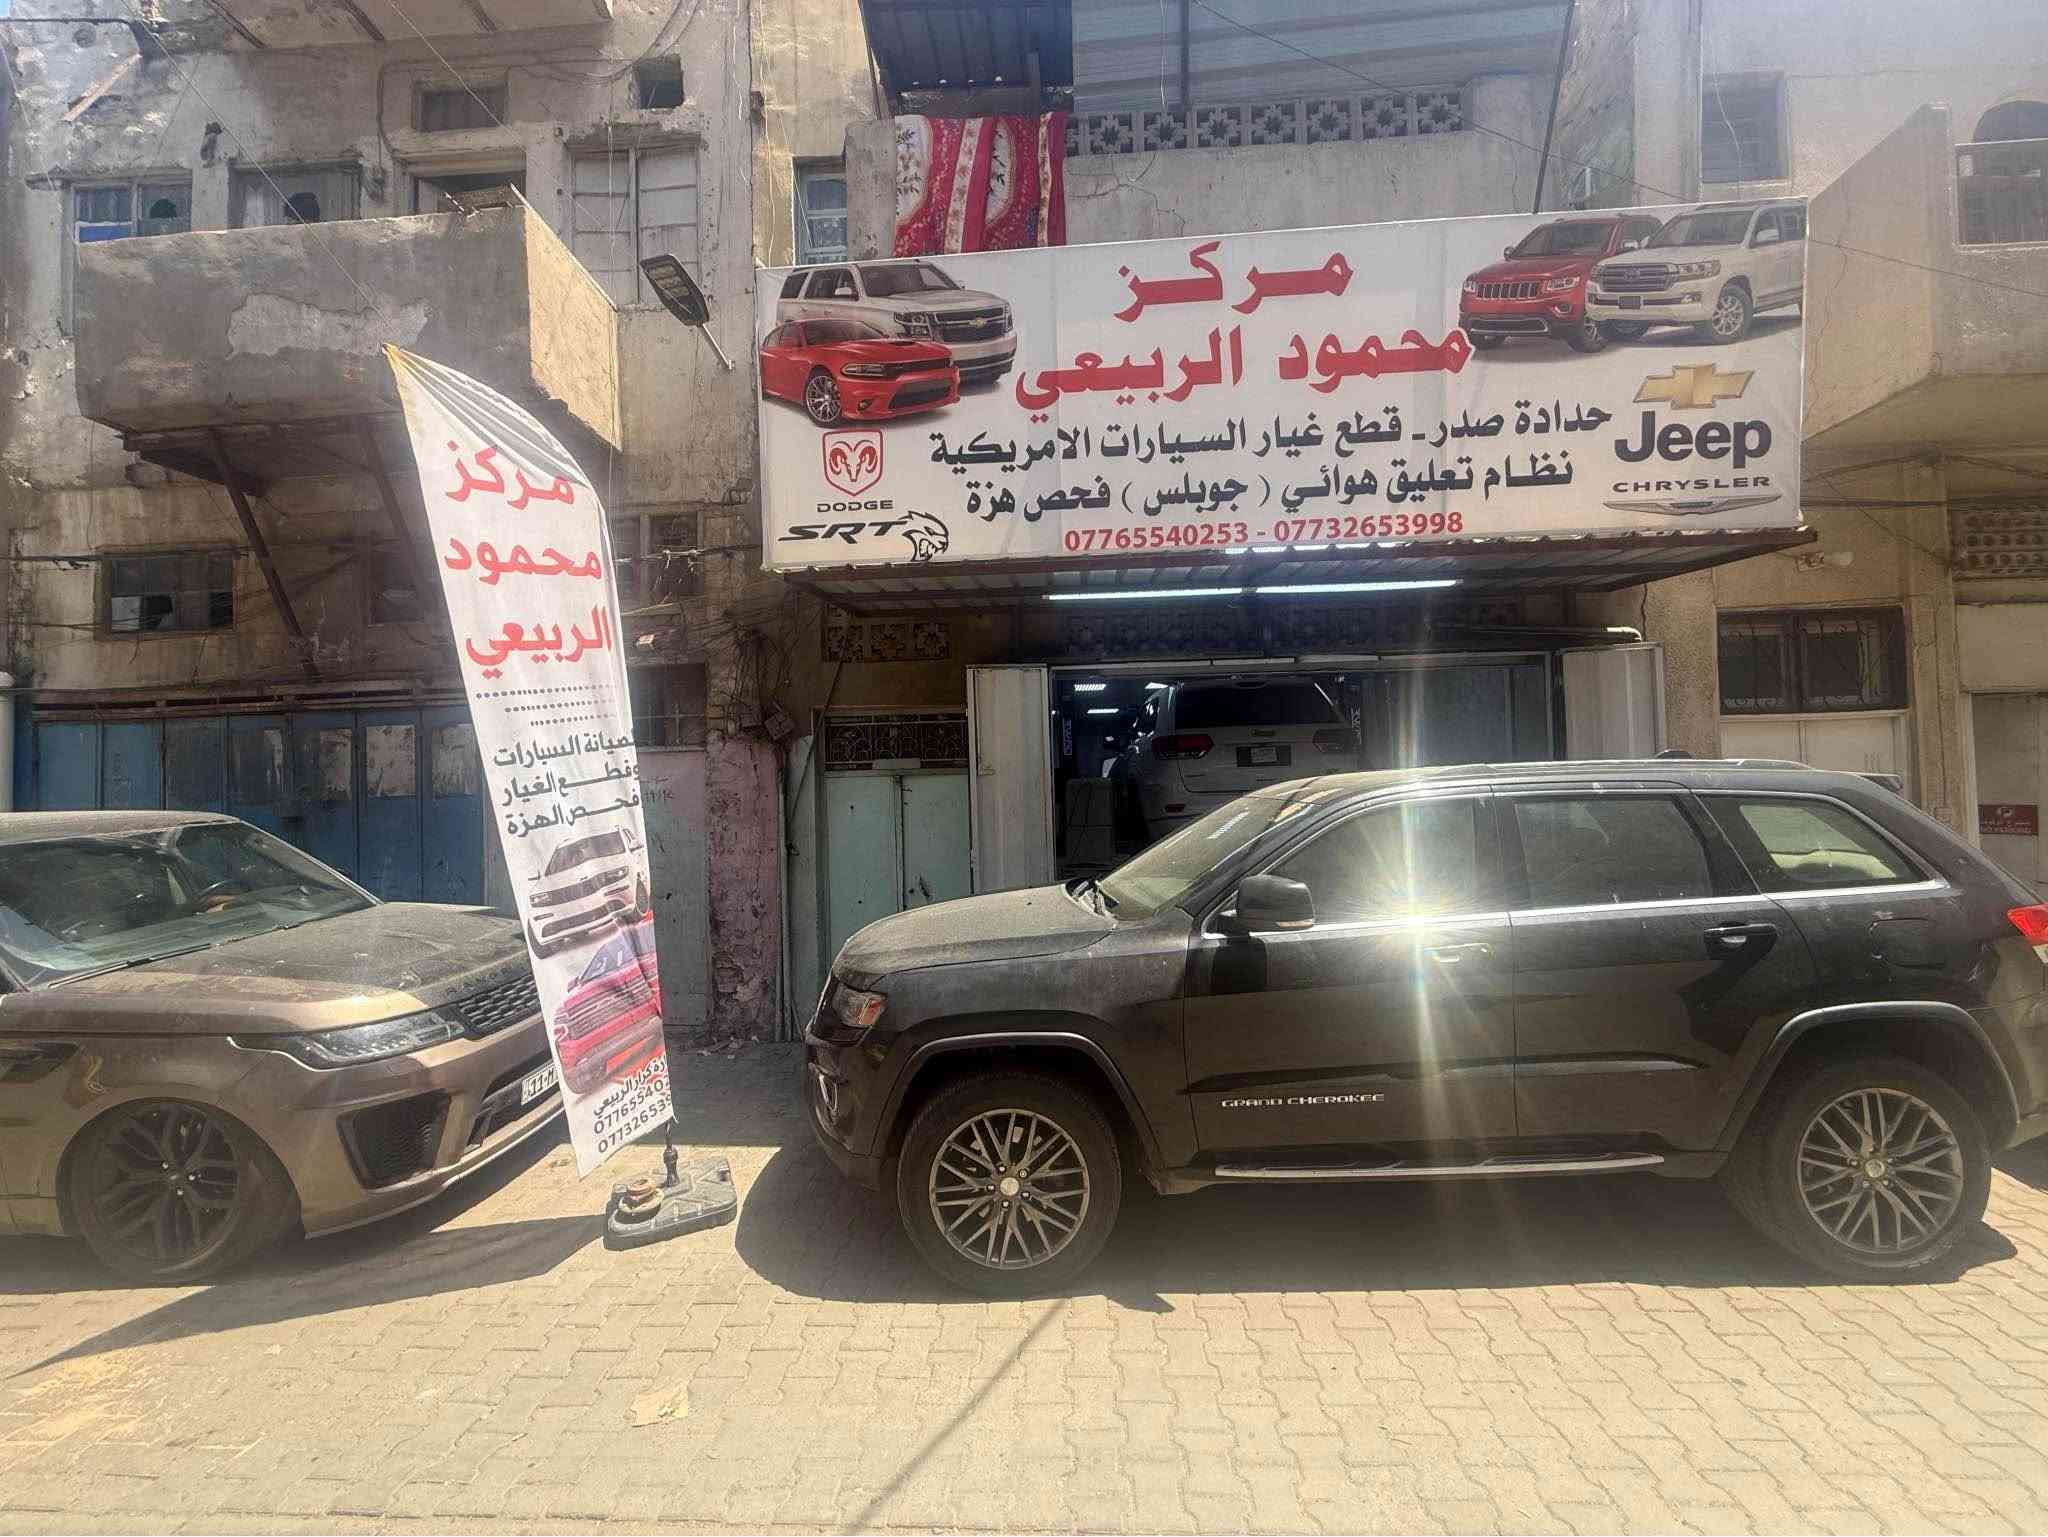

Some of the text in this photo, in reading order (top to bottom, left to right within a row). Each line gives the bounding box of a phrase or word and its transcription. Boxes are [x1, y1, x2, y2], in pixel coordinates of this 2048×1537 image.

[1113, 240, 1354, 323] مركز
[1015, 323, 1474, 423] محمود الربيعي
[1100, 416, 1247, 465] السيارات
[1253, 411, 1323, 459] غيار
[1335, 405, 1402, 458] قطع
[1514, 399, 1613, 436] حدادة
[1613, 410, 1772, 469] Jeep
[445, 440, 575, 510] مركز
[1281, 460, 1378, 514] هوائي
[1386, 455, 1474, 504] تعليق
[1483, 446, 1575, 501] نظام
[1612, 475, 1771, 494] CHRYSLER
[816, 499, 894, 513] DODGE
[966, 479, 1016, 524] هزة
[1022, 474, 1111, 523] فحص
[777, 520, 908, 545] SRT
[1064, 521, 1249, 553] 07765540253
[1273, 511, 1464, 545] 07732653998
[444, 538, 603, 586] محمود
[465, 604, 613, 680] الربيعي
[493, 735, 582, 769] السيارات
[501, 769, 557, 806] الغيار
[506, 803, 565, 838] الهزة
[1221, 1093, 1385, 1108] GRAND CHEROKEE
